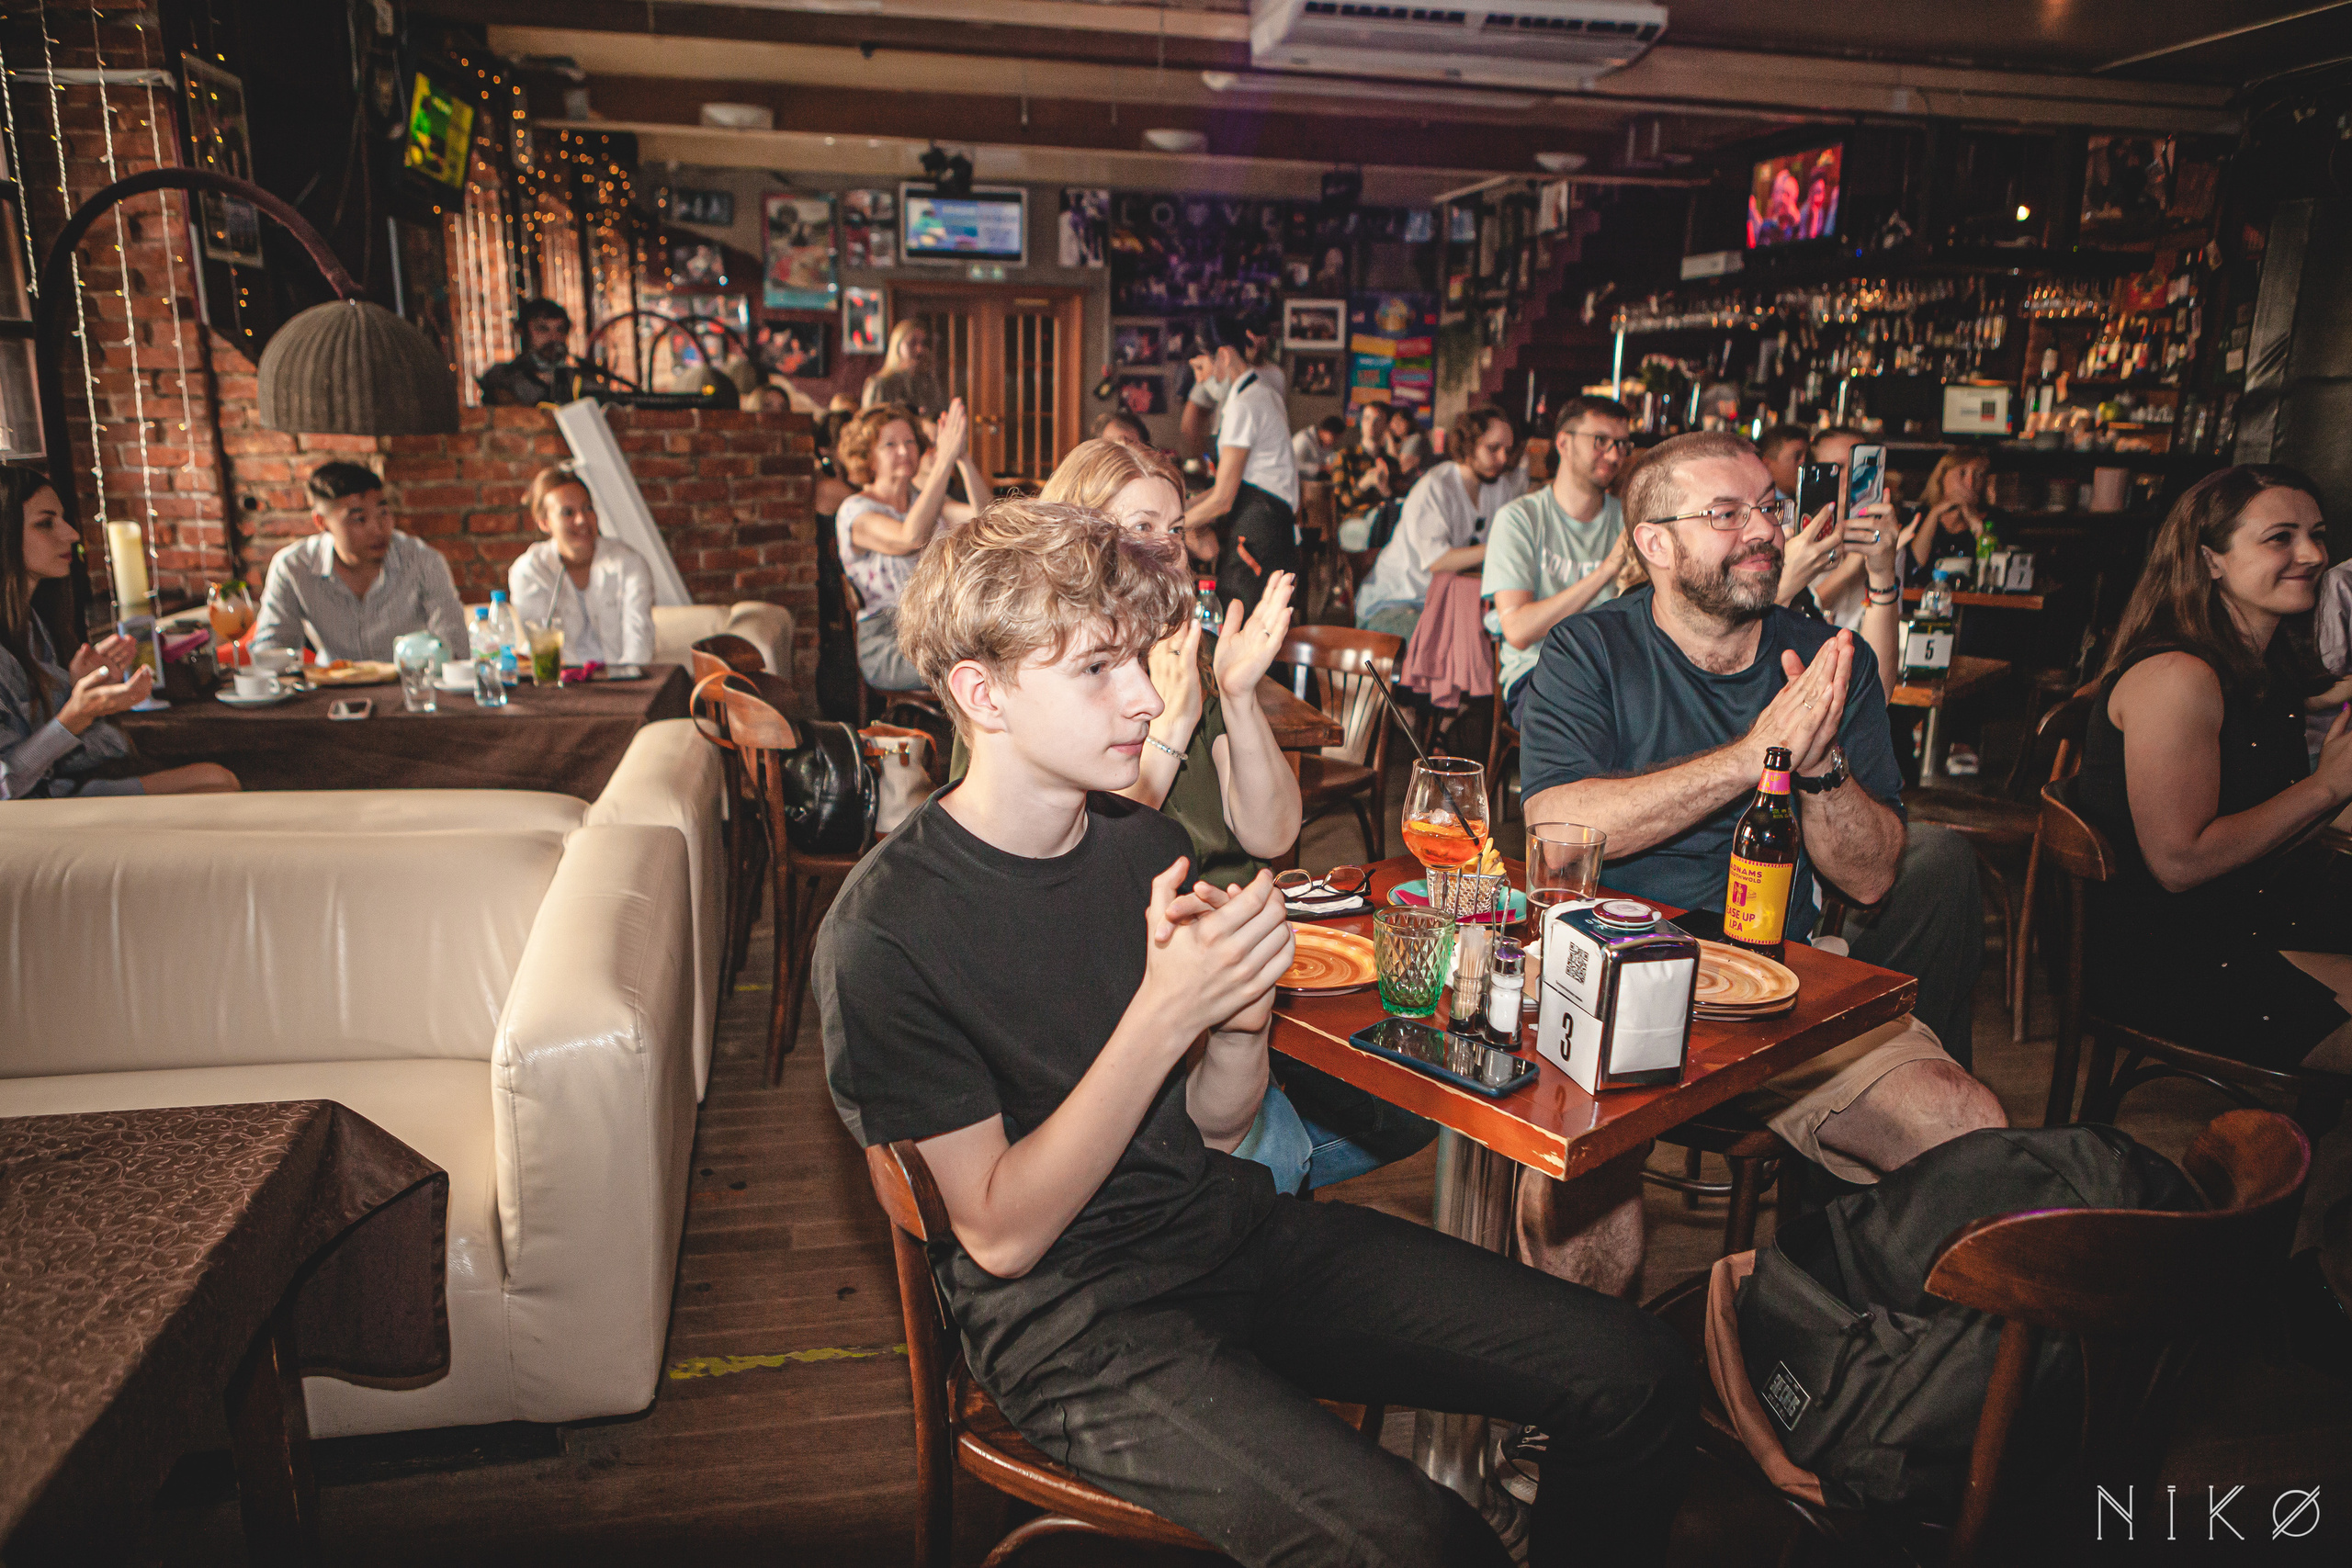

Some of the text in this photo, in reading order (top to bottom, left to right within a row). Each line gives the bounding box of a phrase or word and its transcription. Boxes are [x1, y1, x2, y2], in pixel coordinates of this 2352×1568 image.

[1924, 639, 1935, 660] 5
[1742, 912, 1756, 922] UP
[1560, 1011, 1574, 1062] 3
